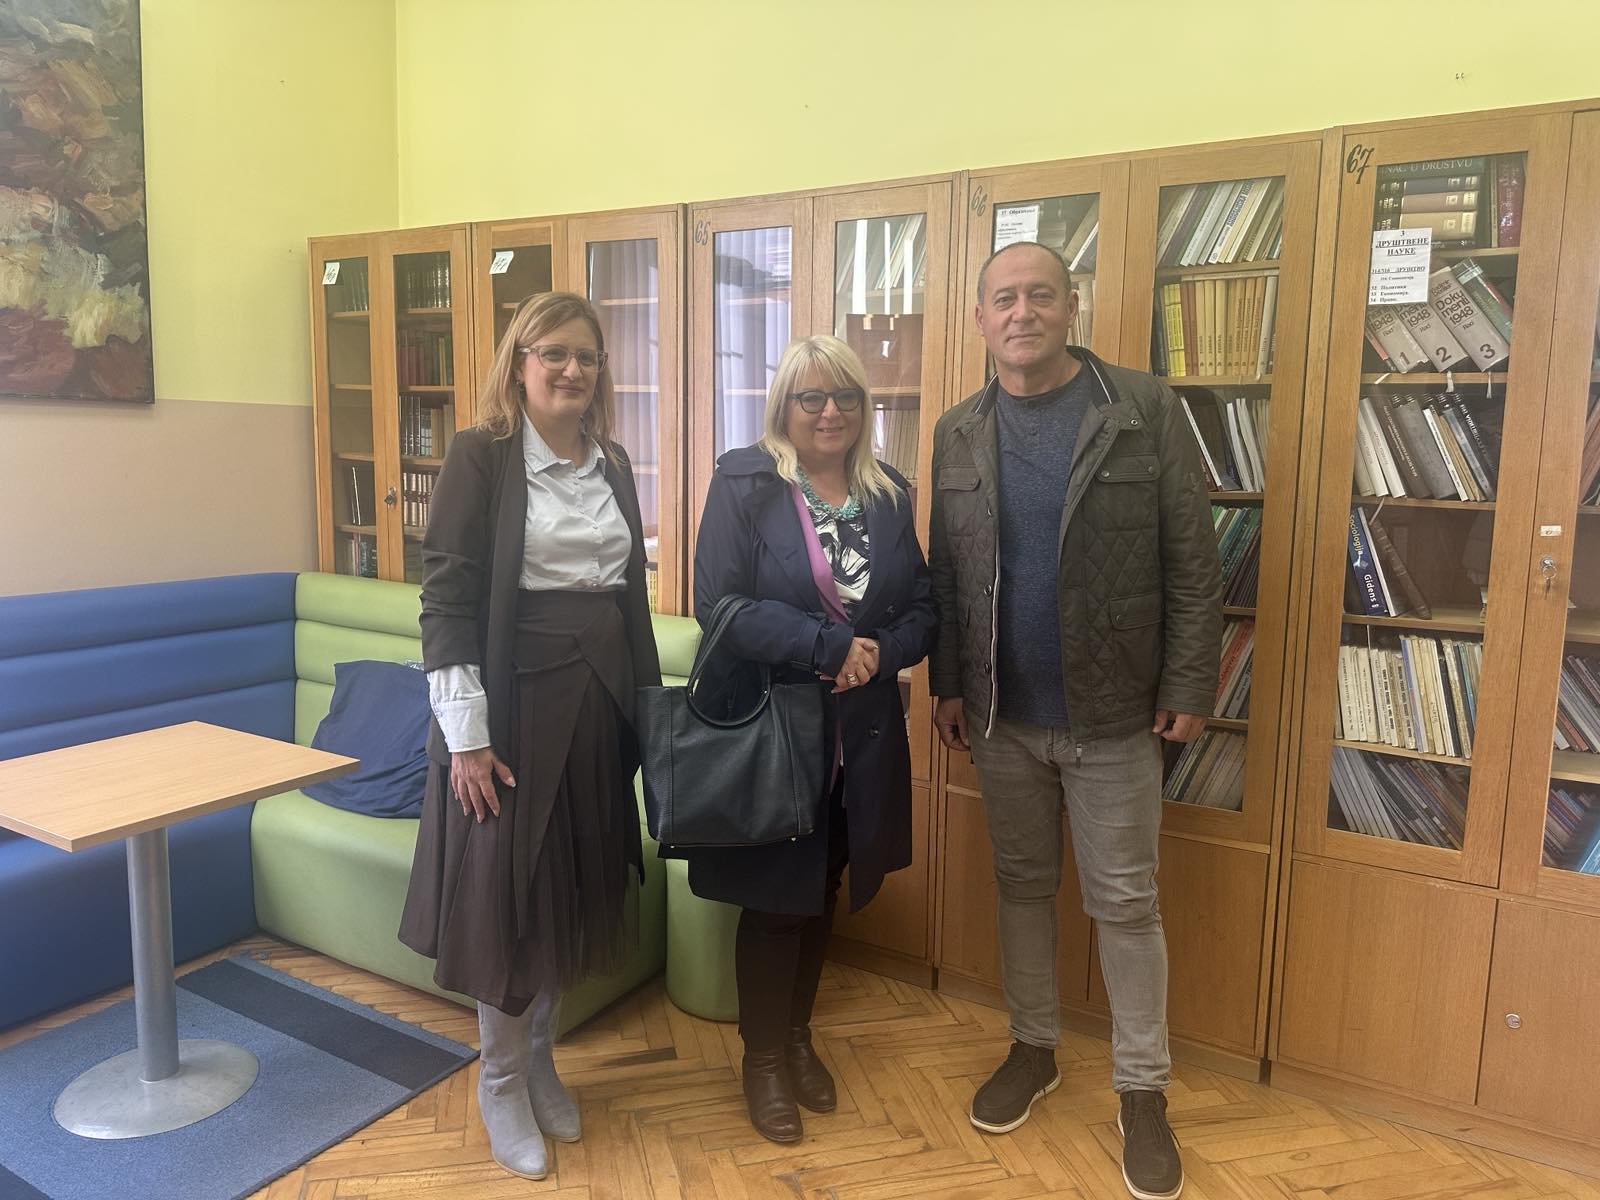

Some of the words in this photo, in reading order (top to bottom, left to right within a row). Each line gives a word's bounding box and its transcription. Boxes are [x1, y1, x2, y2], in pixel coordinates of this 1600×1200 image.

[1346, 144, 1375, 185] 67
[971, 185, 988, 217] 66
[695, 220, 711, 246] 65
[1375, 237, 1430, 249] ДРУШТВЕНЕ
[1387, 247, 1417, 257] НАУКЕ
[1408, 308, 1431, 328] 1948
[1449, 306, 1474, 326] 1948
[1400, 352, 1410, 366] 1
[1436, 346, 1452, 363] 2
[1480, 344, 1496, 360] 3
[1350, 514, 1364, 555] Sociologija
[1364, 574, 1377, 603] Gidens
